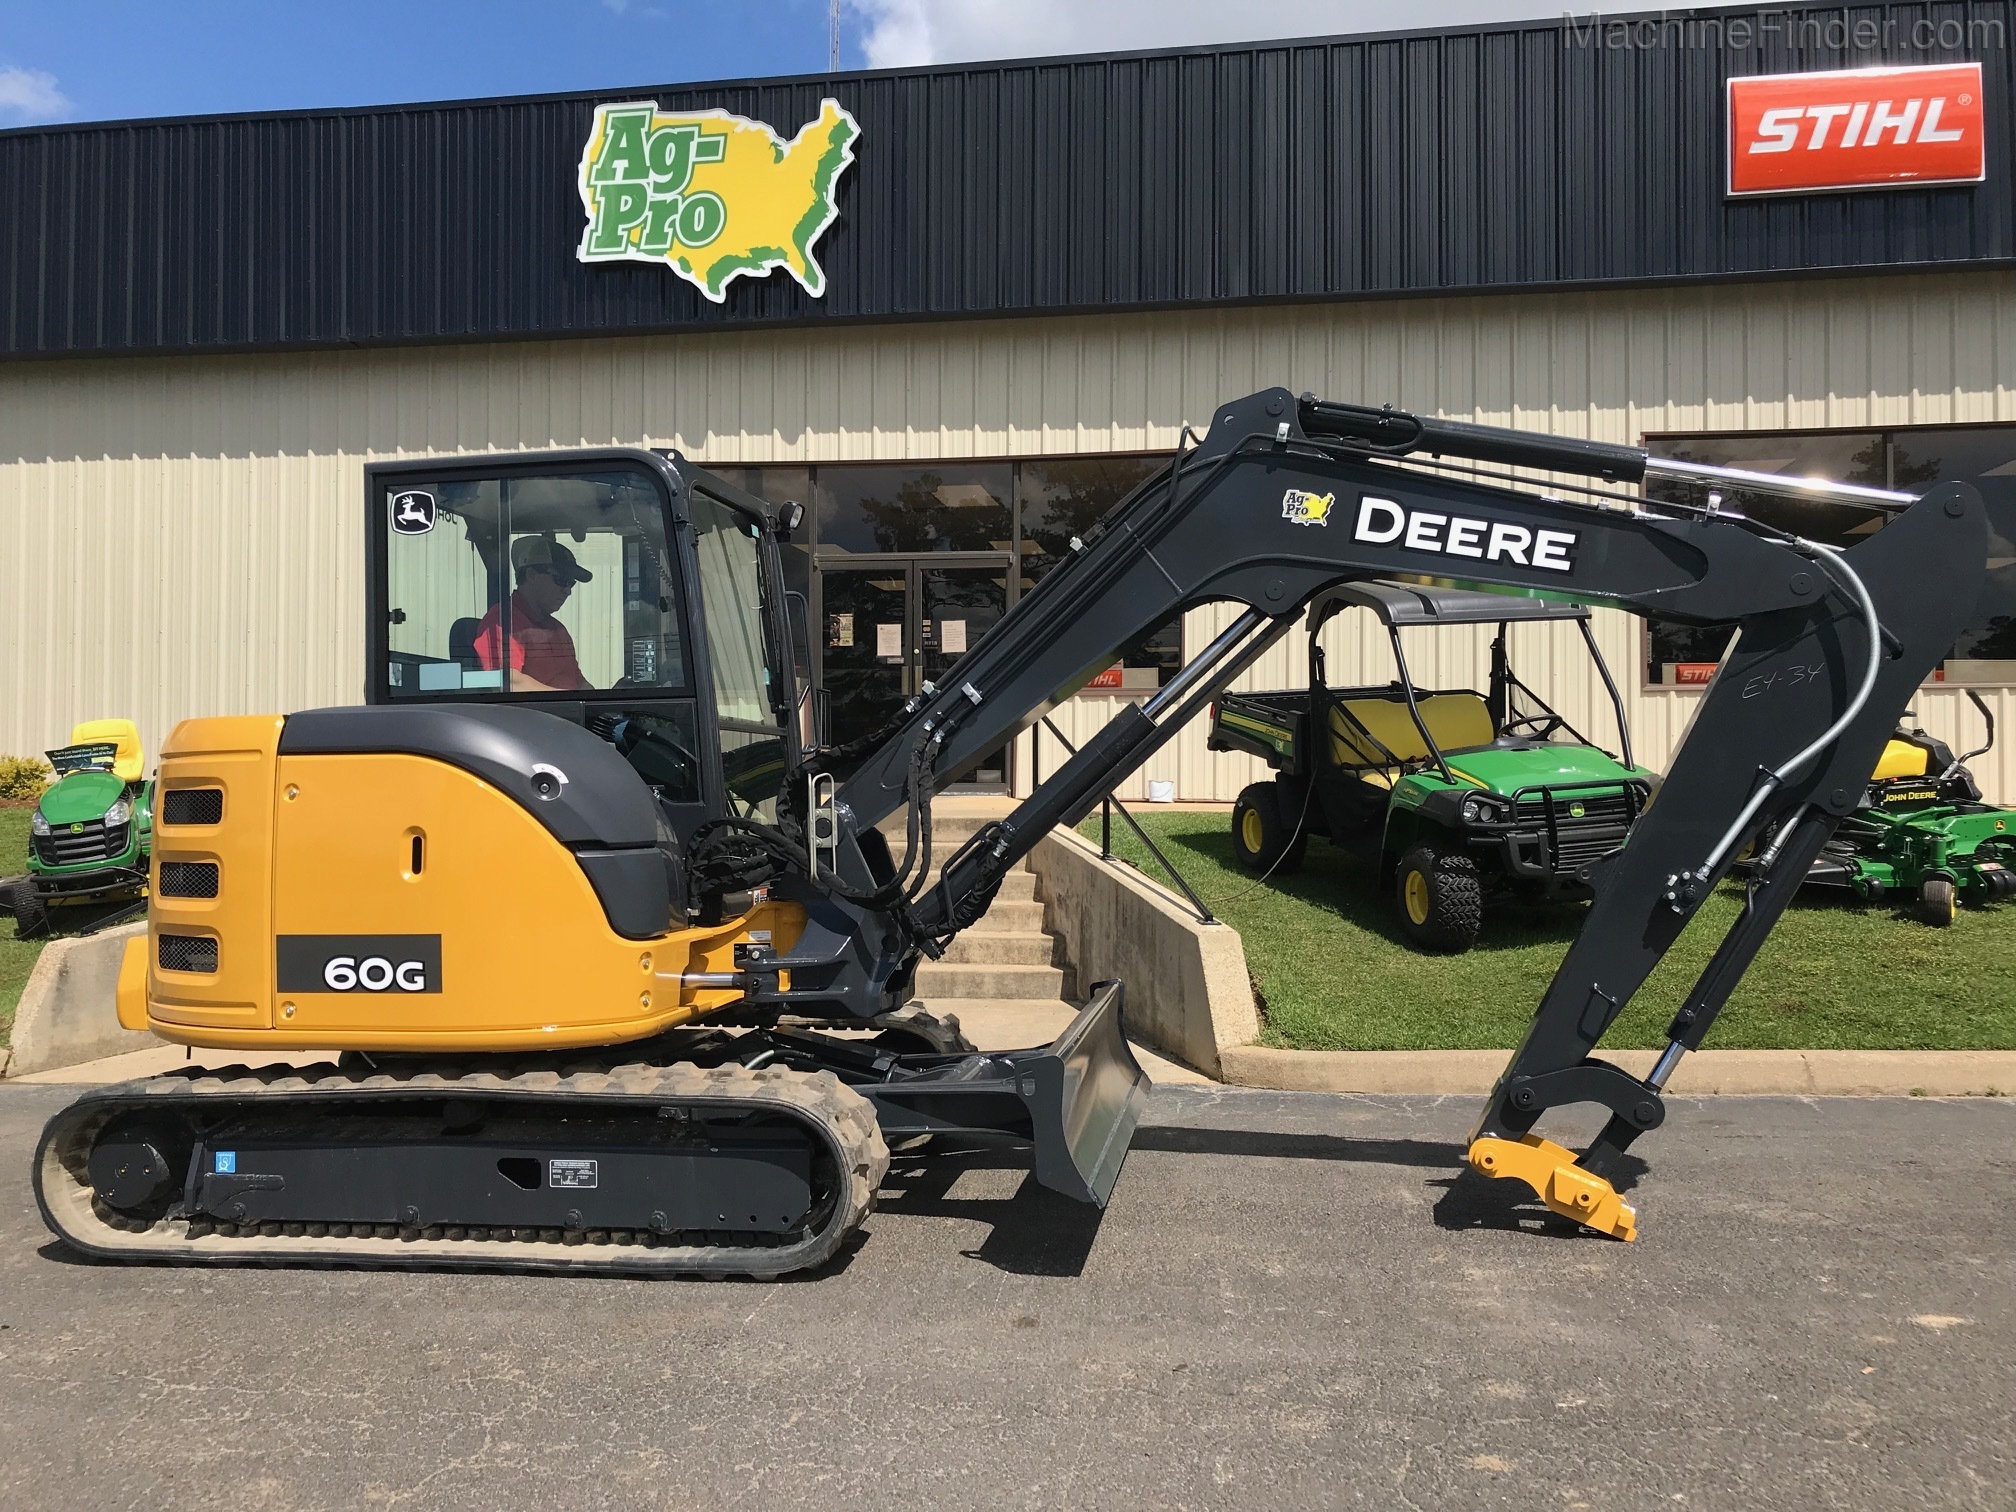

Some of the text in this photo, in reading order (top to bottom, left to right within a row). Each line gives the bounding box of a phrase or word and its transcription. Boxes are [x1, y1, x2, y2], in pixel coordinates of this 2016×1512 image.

[1748, 97, 1965, 154] STIHL
[588, 107, 727, 197] Ag-
[587, 183, 726, 255] Pro
[1285, 504, 1309, 516] Pro
[1286, 492, 1310, 506] Ag-
[1355, 497, 1576, 571] DEERE
[1883, 791, 1937, 803] JOHN DEERE
[324, 957, 425, 991] 60G
